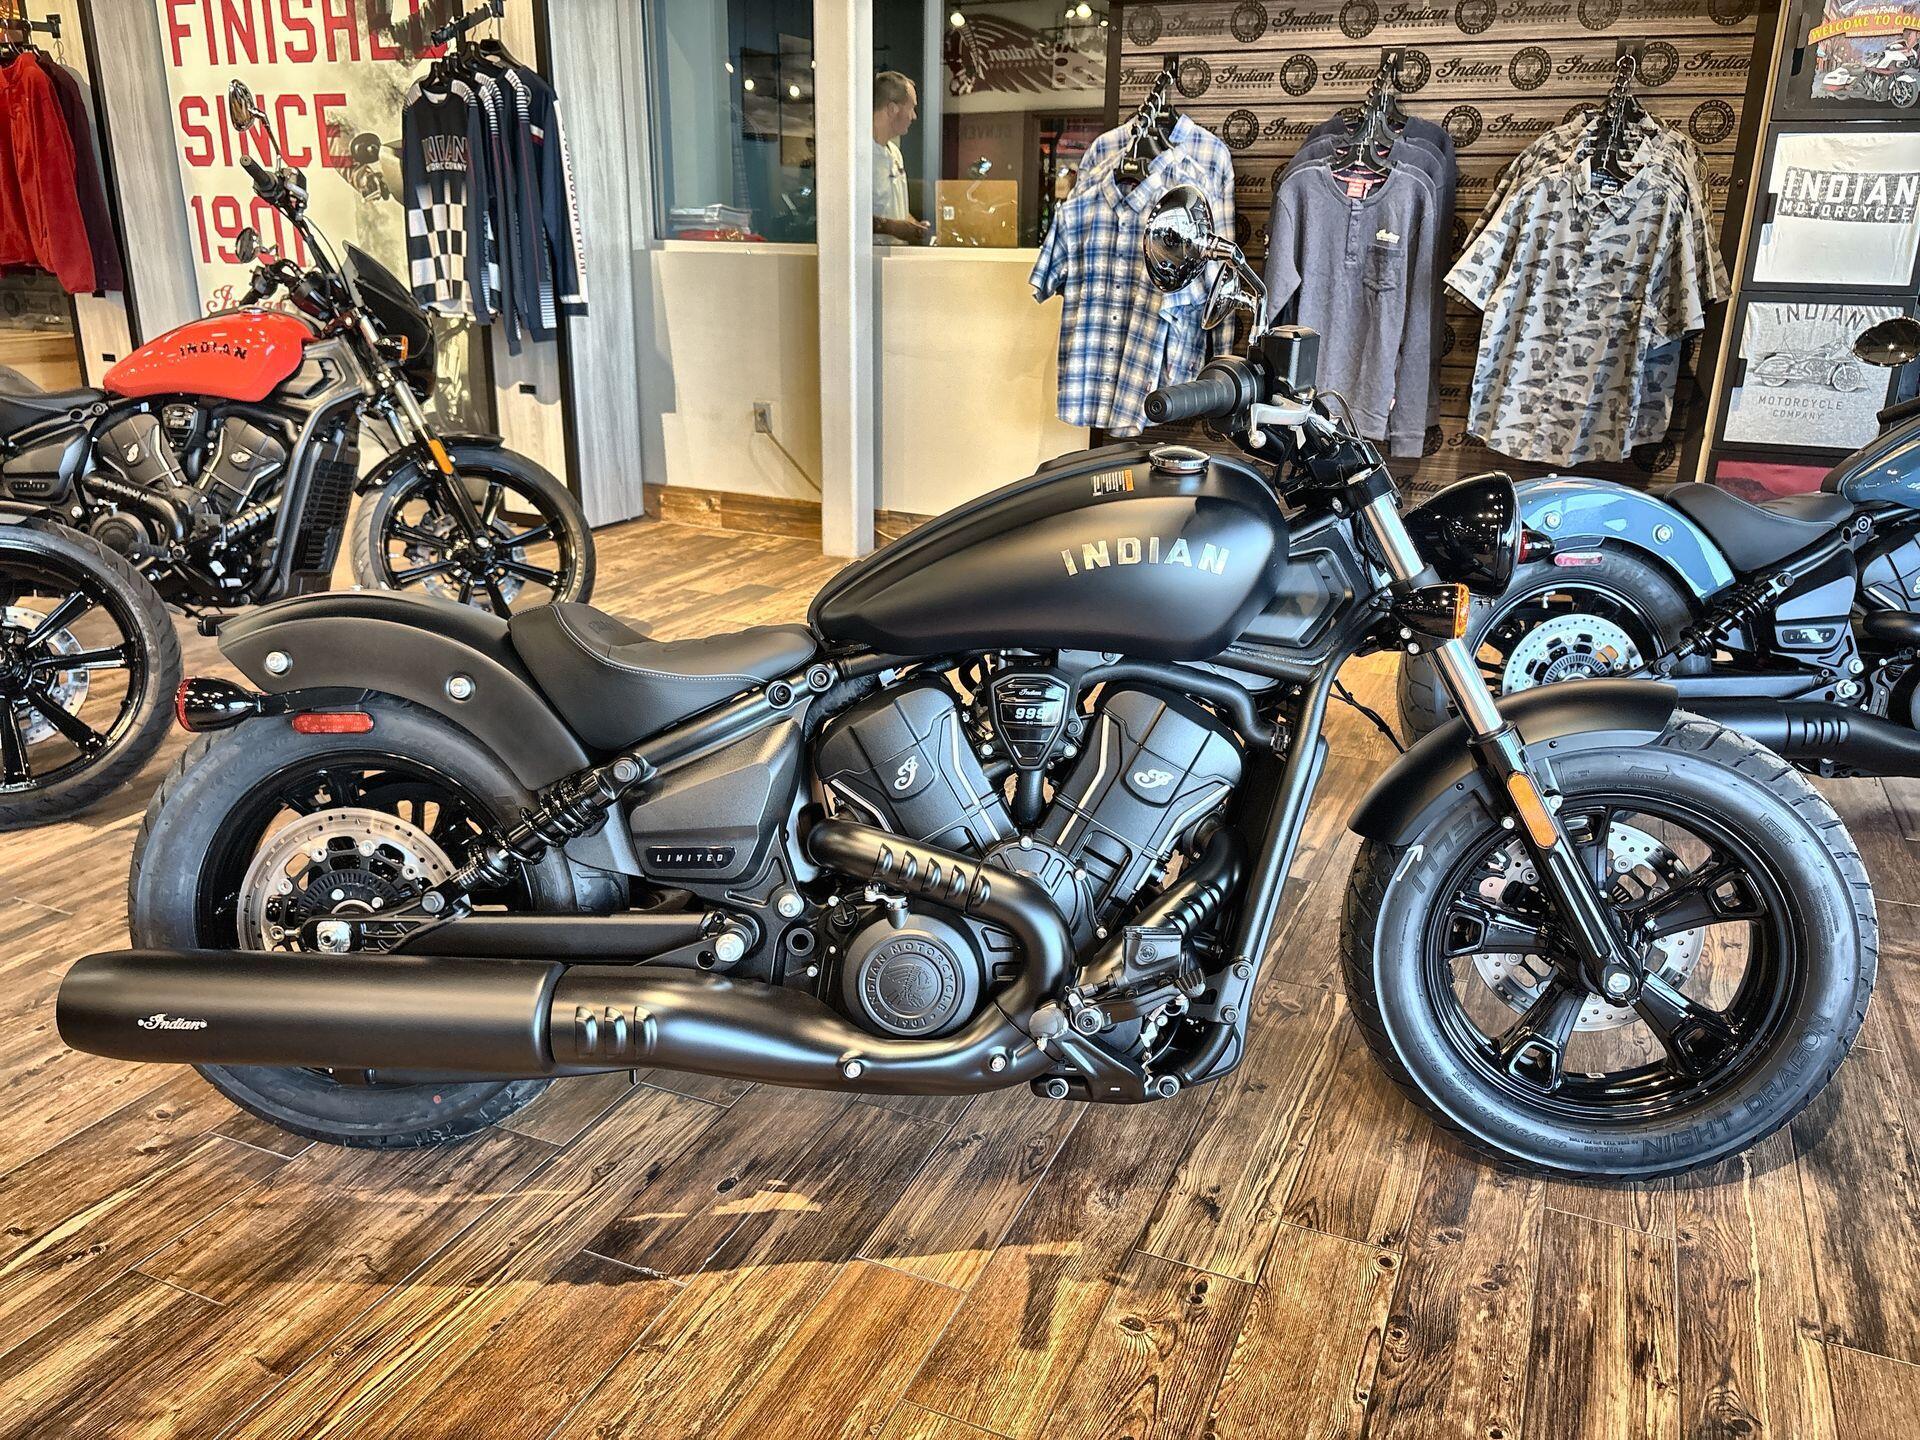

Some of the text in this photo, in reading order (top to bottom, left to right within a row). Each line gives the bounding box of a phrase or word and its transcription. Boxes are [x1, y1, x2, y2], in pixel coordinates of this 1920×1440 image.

[1272, 8, 1334, 27] Indian
[1384, 3, 1450, 23] Indian
[1811, 16, 1870, 41] WELCOME
[1874, 15, 1890, 26] TO
[1215, 65, 1275, 83] Indian
[1435, 58, 1502, 78] Indian
[179, 93, 350, 168] SINCE
[1263, 117, 1314, 135] India
[1784, 171, 1919, 206] INDIAN
[1781, 200, 1914, 221] MOTORCYCLE
[1775, 303, 1865, 330] INDIAN
[1758, 395, 1843, 411] MOTORCYCLE
[1772, 411, 1825, 420] COMPANY
[1060, 537, 1230, 576] INDIAN
[1790, 632, 1830, 640] LIMED
[1015, 708, 1045, 719] 999
[656, 854, 724, 862] LIMITED
[890, 942, 954, 1012] MOTORCYCLE
[143, 1012, 201, 1031] Indian
[1643, 1012, 1832, 1158] NIGHT DRAGON
